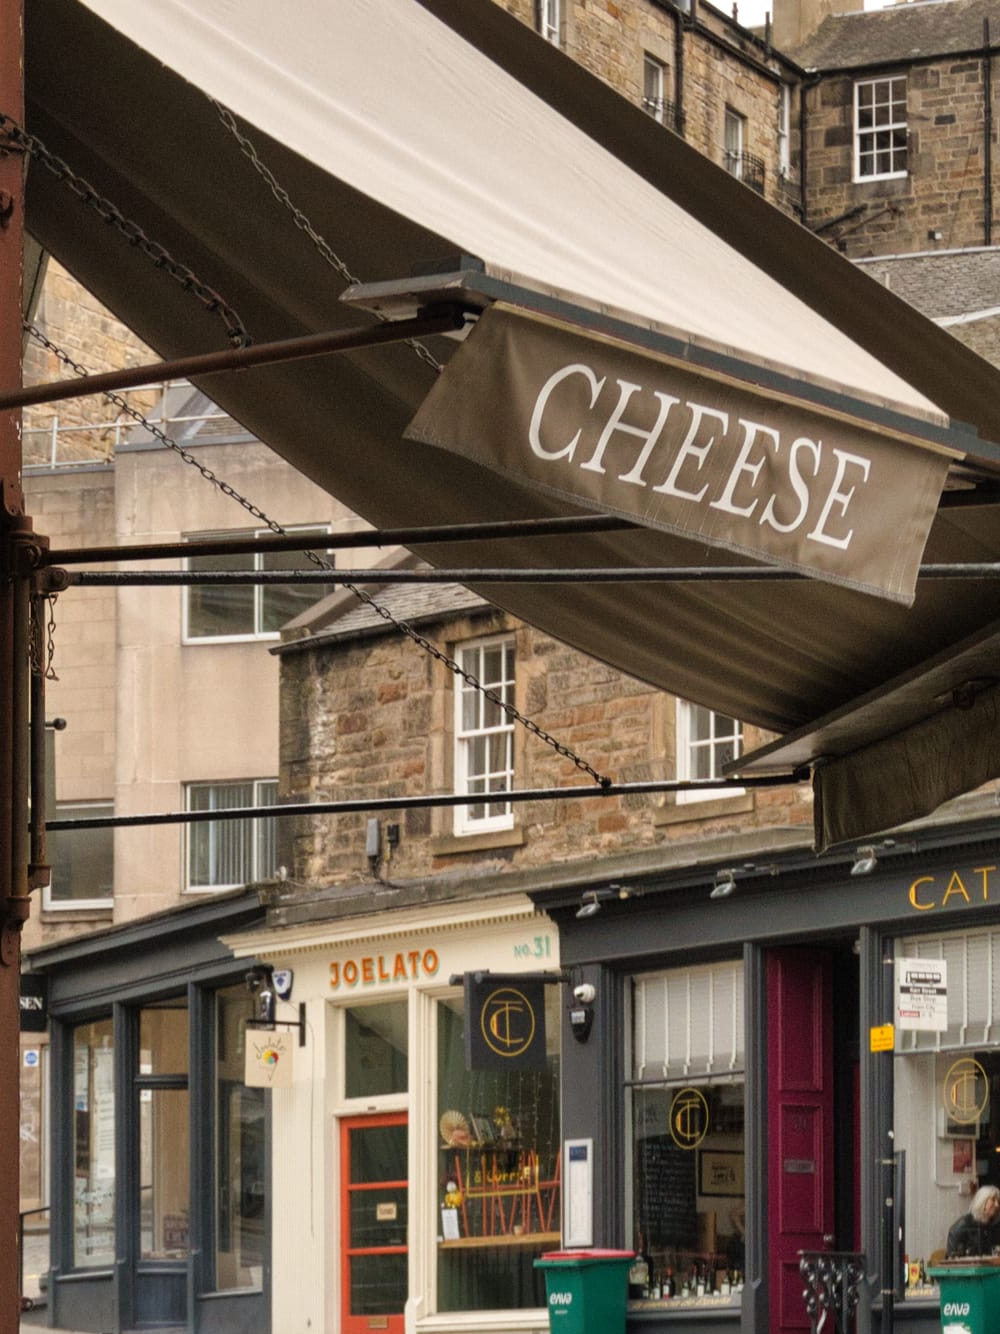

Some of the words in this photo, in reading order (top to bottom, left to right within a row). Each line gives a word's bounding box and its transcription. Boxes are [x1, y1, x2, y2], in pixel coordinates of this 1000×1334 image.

[527, 363, 871, 551] CHEESE
[909, 865, 997, 911] CAT
[329, 948, 440, 991] JOELATO
[549, 1291, 573, 1305] enva
[943, 1302, 971, 1316] enva
